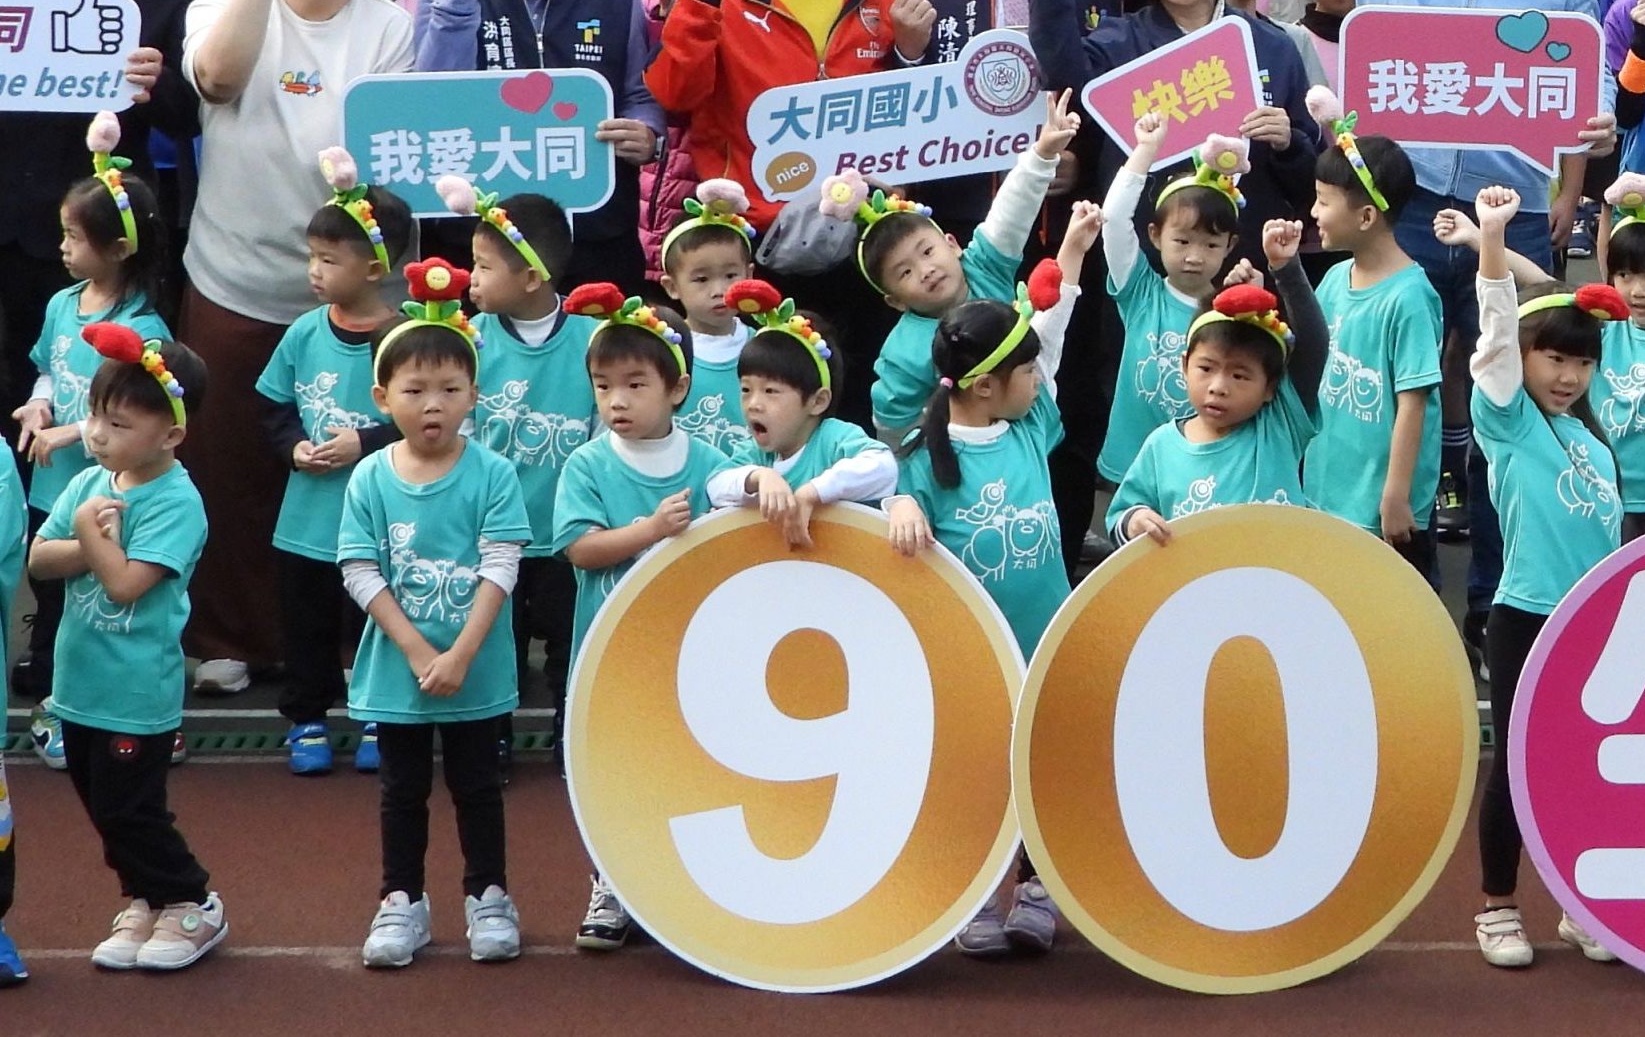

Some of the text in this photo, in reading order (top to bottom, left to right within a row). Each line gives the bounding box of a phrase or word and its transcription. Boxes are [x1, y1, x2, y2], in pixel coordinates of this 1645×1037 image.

[574, 44, 603, 54] TAIPEI
[34, 67, 124, 98] best!
[767, 76, 959, 145] 大同國小
[1132, 55, 1235, 123] 快樂
[1367, 59, 1577, 119] 我愛大同
[370, 126, 586, 186] 我愛大同
[775, 160, 810, 185] nice
[835, 145, 906, 175] Best
[670, 561, 935, 925] 9
[1114, 566, 1378, 931] 0
